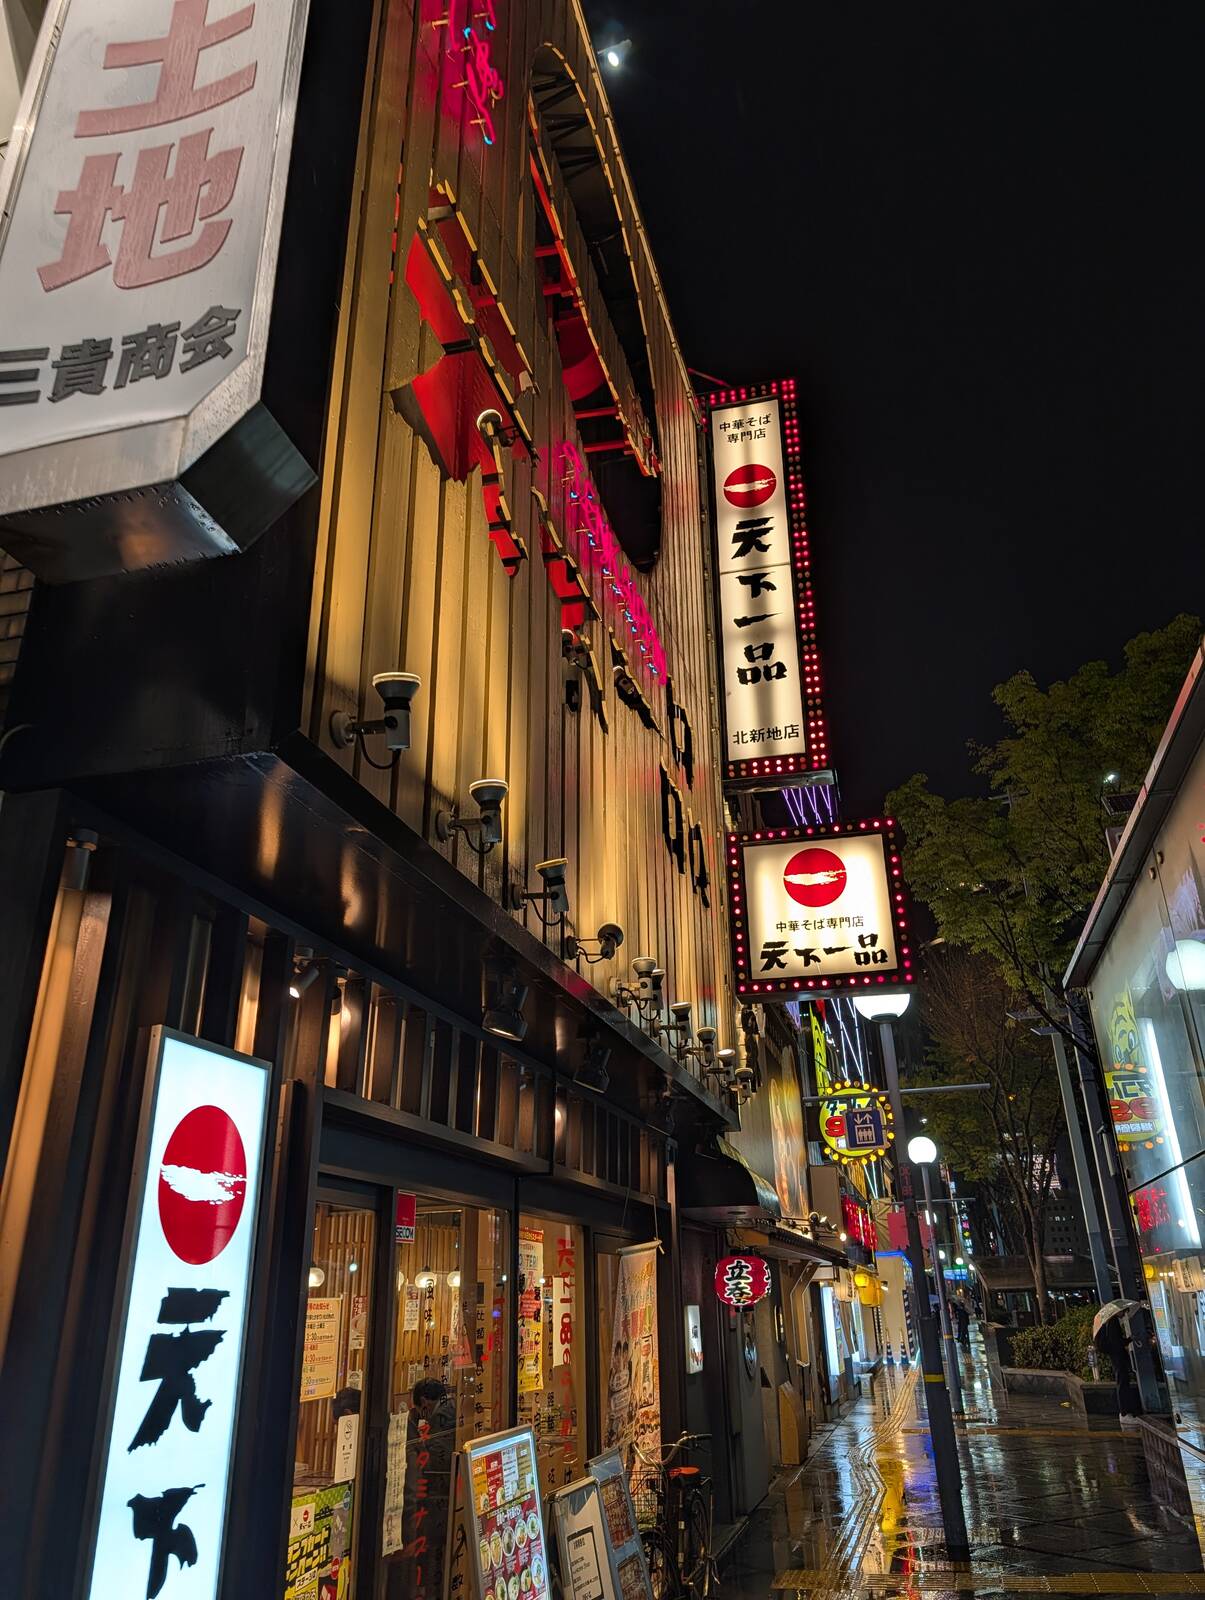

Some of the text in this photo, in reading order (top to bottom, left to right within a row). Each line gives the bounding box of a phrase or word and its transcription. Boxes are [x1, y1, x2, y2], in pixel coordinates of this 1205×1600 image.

[719, 413, 771, 433] 中華そば
[727, 428, 767, 444] 専門店
[731, 516, 788, 686] 天下一品
[733, 725, 800, 744] 北新地店
[776, 916, 864, 932] 中華そば専門店
[760, 933, 888, 972] 天下一品
[128, 1287, 230, 1600] 天下
